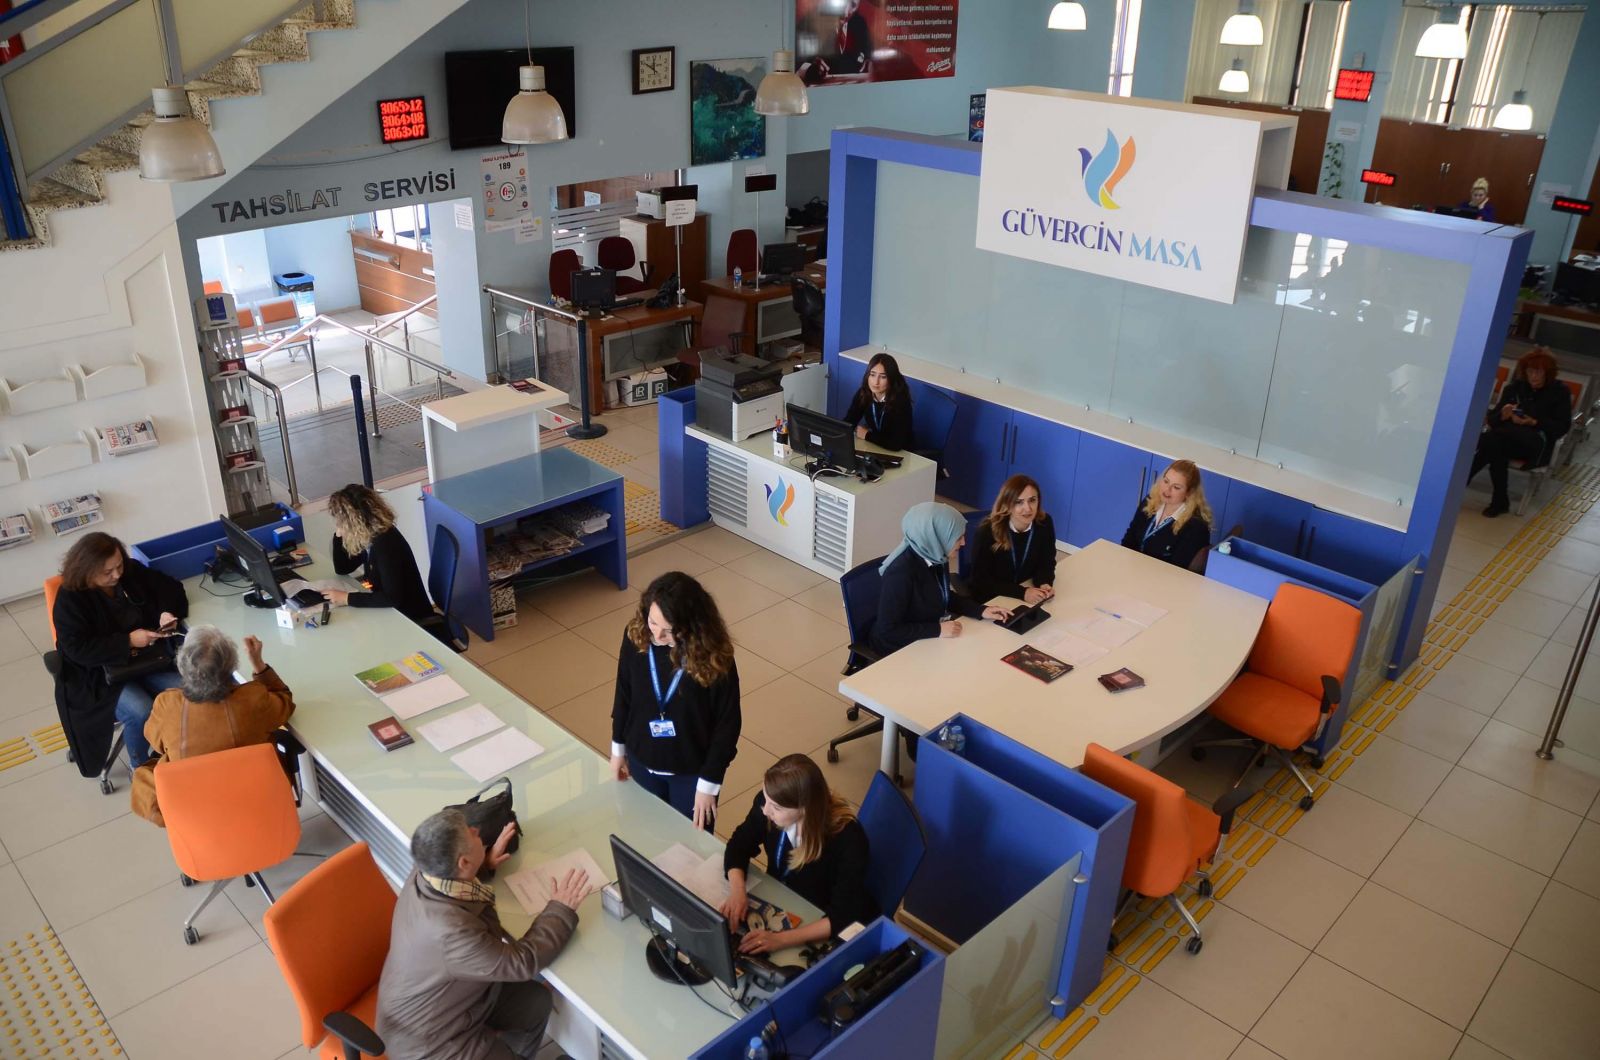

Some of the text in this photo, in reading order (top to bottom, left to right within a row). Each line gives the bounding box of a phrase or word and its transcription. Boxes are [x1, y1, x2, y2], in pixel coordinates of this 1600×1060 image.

[499, 162, 511, 170] 189
[212, 168, 456, 223] TAHSİLAT SERVİSİ
[1002, 208, 1202, 271] GÜVERCİN MASA
